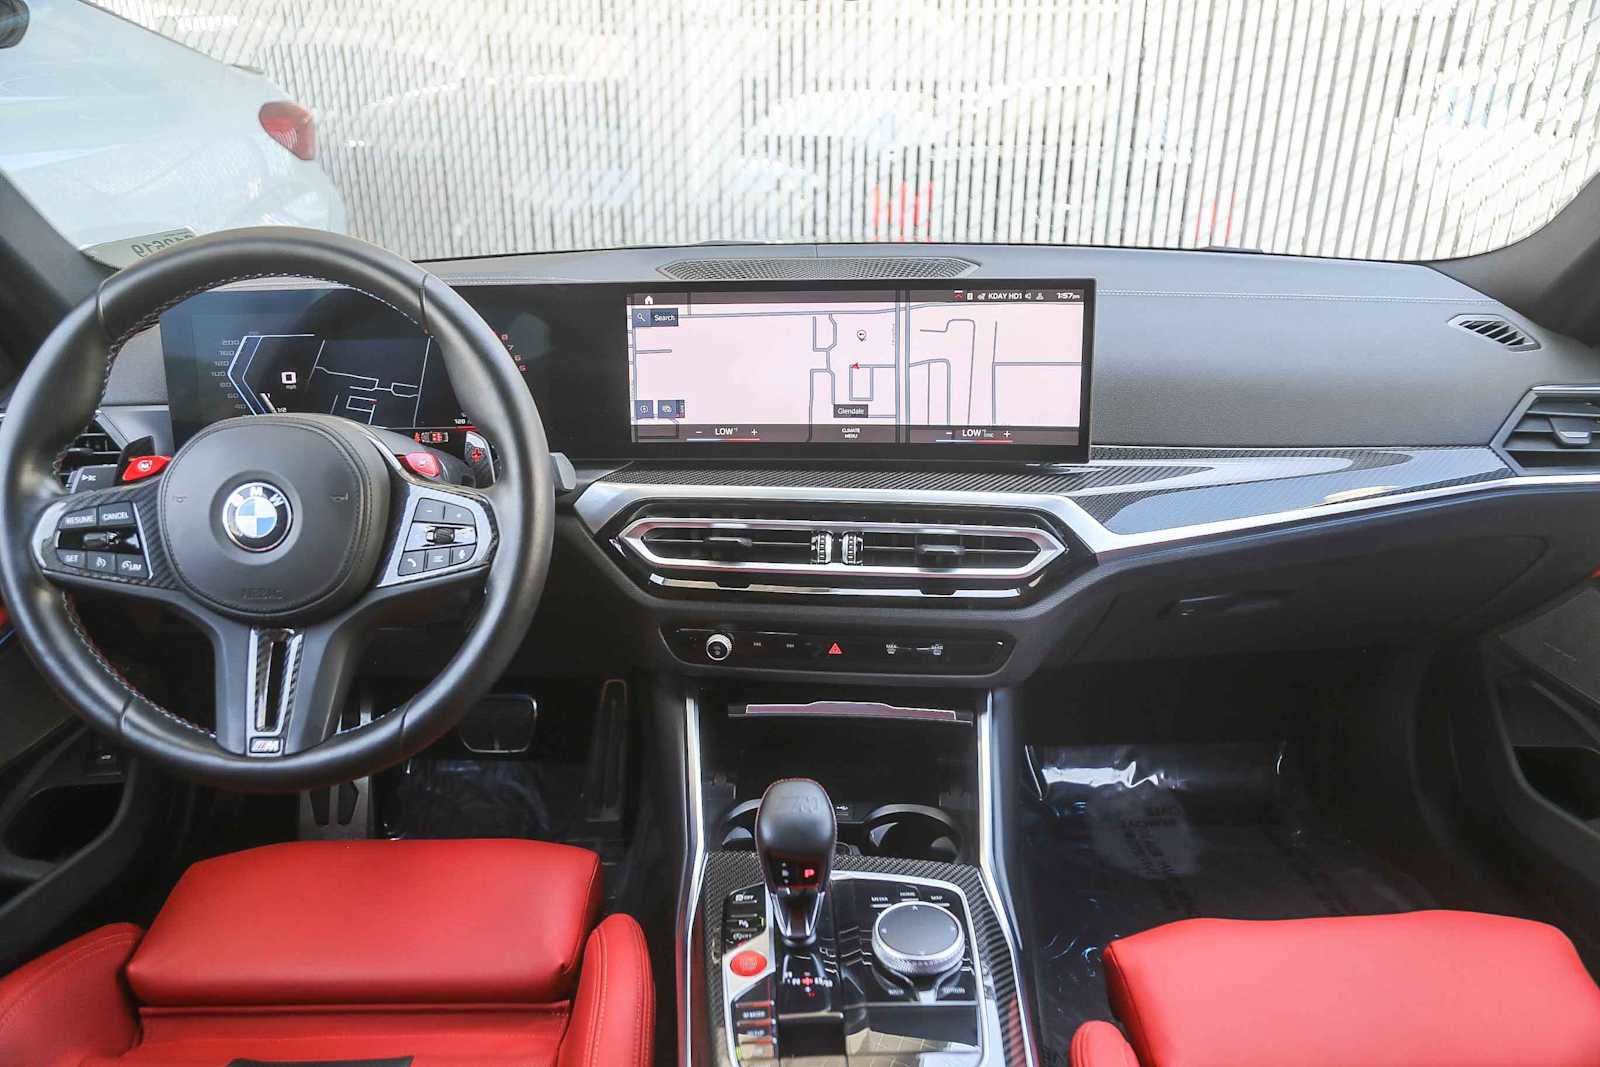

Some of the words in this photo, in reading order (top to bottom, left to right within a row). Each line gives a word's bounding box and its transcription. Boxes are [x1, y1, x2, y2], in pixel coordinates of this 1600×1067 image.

[654, 314, 675, 322] Search
[281, 371, 297, 384] 0
[837, 407, 865, 415] Glendale
[65, 515, 94, 524] RESUME
[103, 511, 129, 520] CANCEL
[65, 554, 79, 562] SET
[804, 869, 815, 878] P
